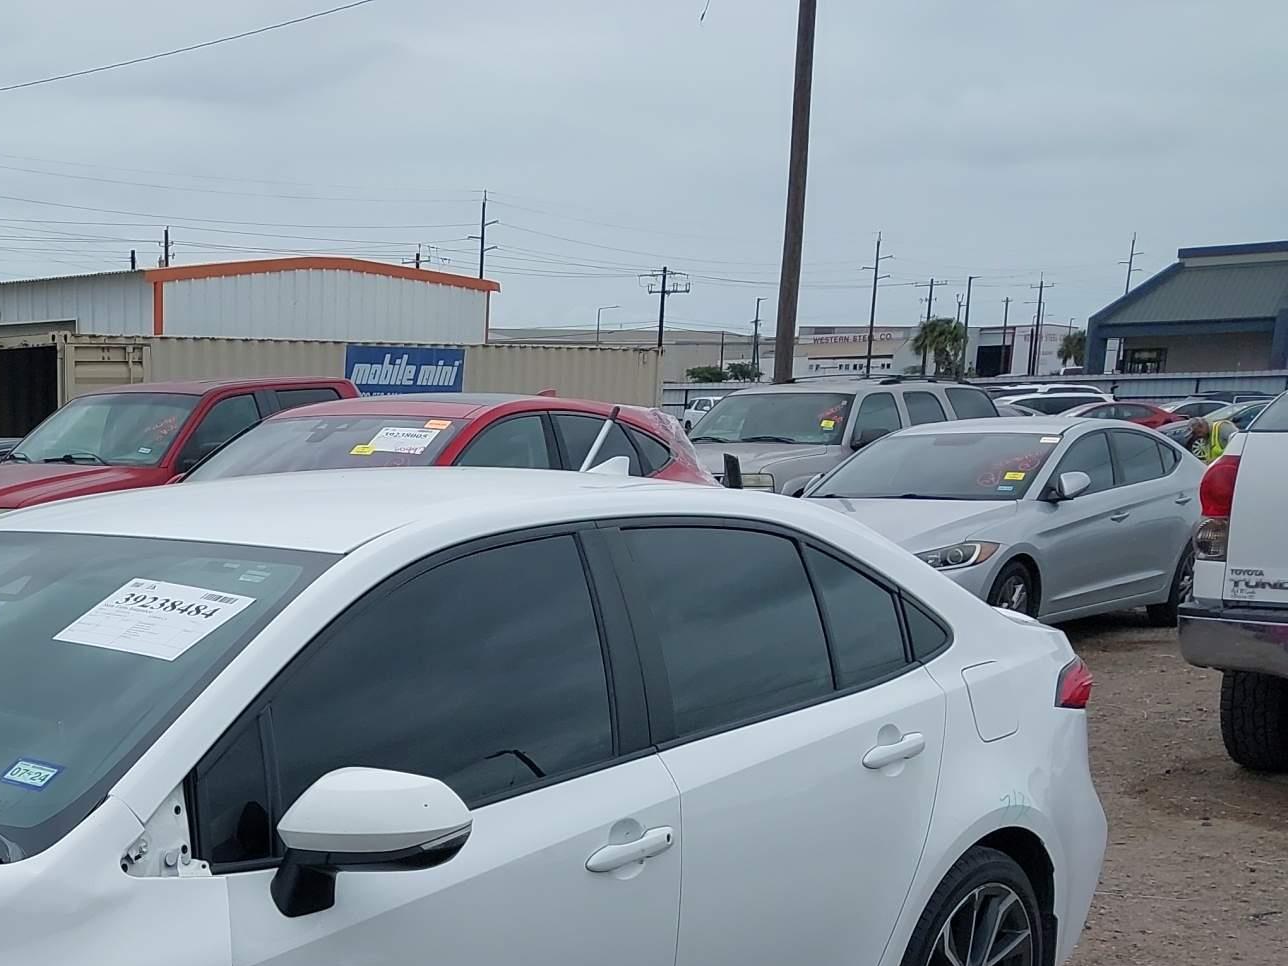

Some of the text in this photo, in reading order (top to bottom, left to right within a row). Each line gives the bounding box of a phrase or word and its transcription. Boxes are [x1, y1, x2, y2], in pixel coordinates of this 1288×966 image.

[814, 336, 850, 344] WESTERN
[853, 334, 877, 343] STEL
[351, 353, 460, 386] mobile mini
[1231, 569, 1265, 577] TOYOTA
[115, 592, 222, 619] 39238484
